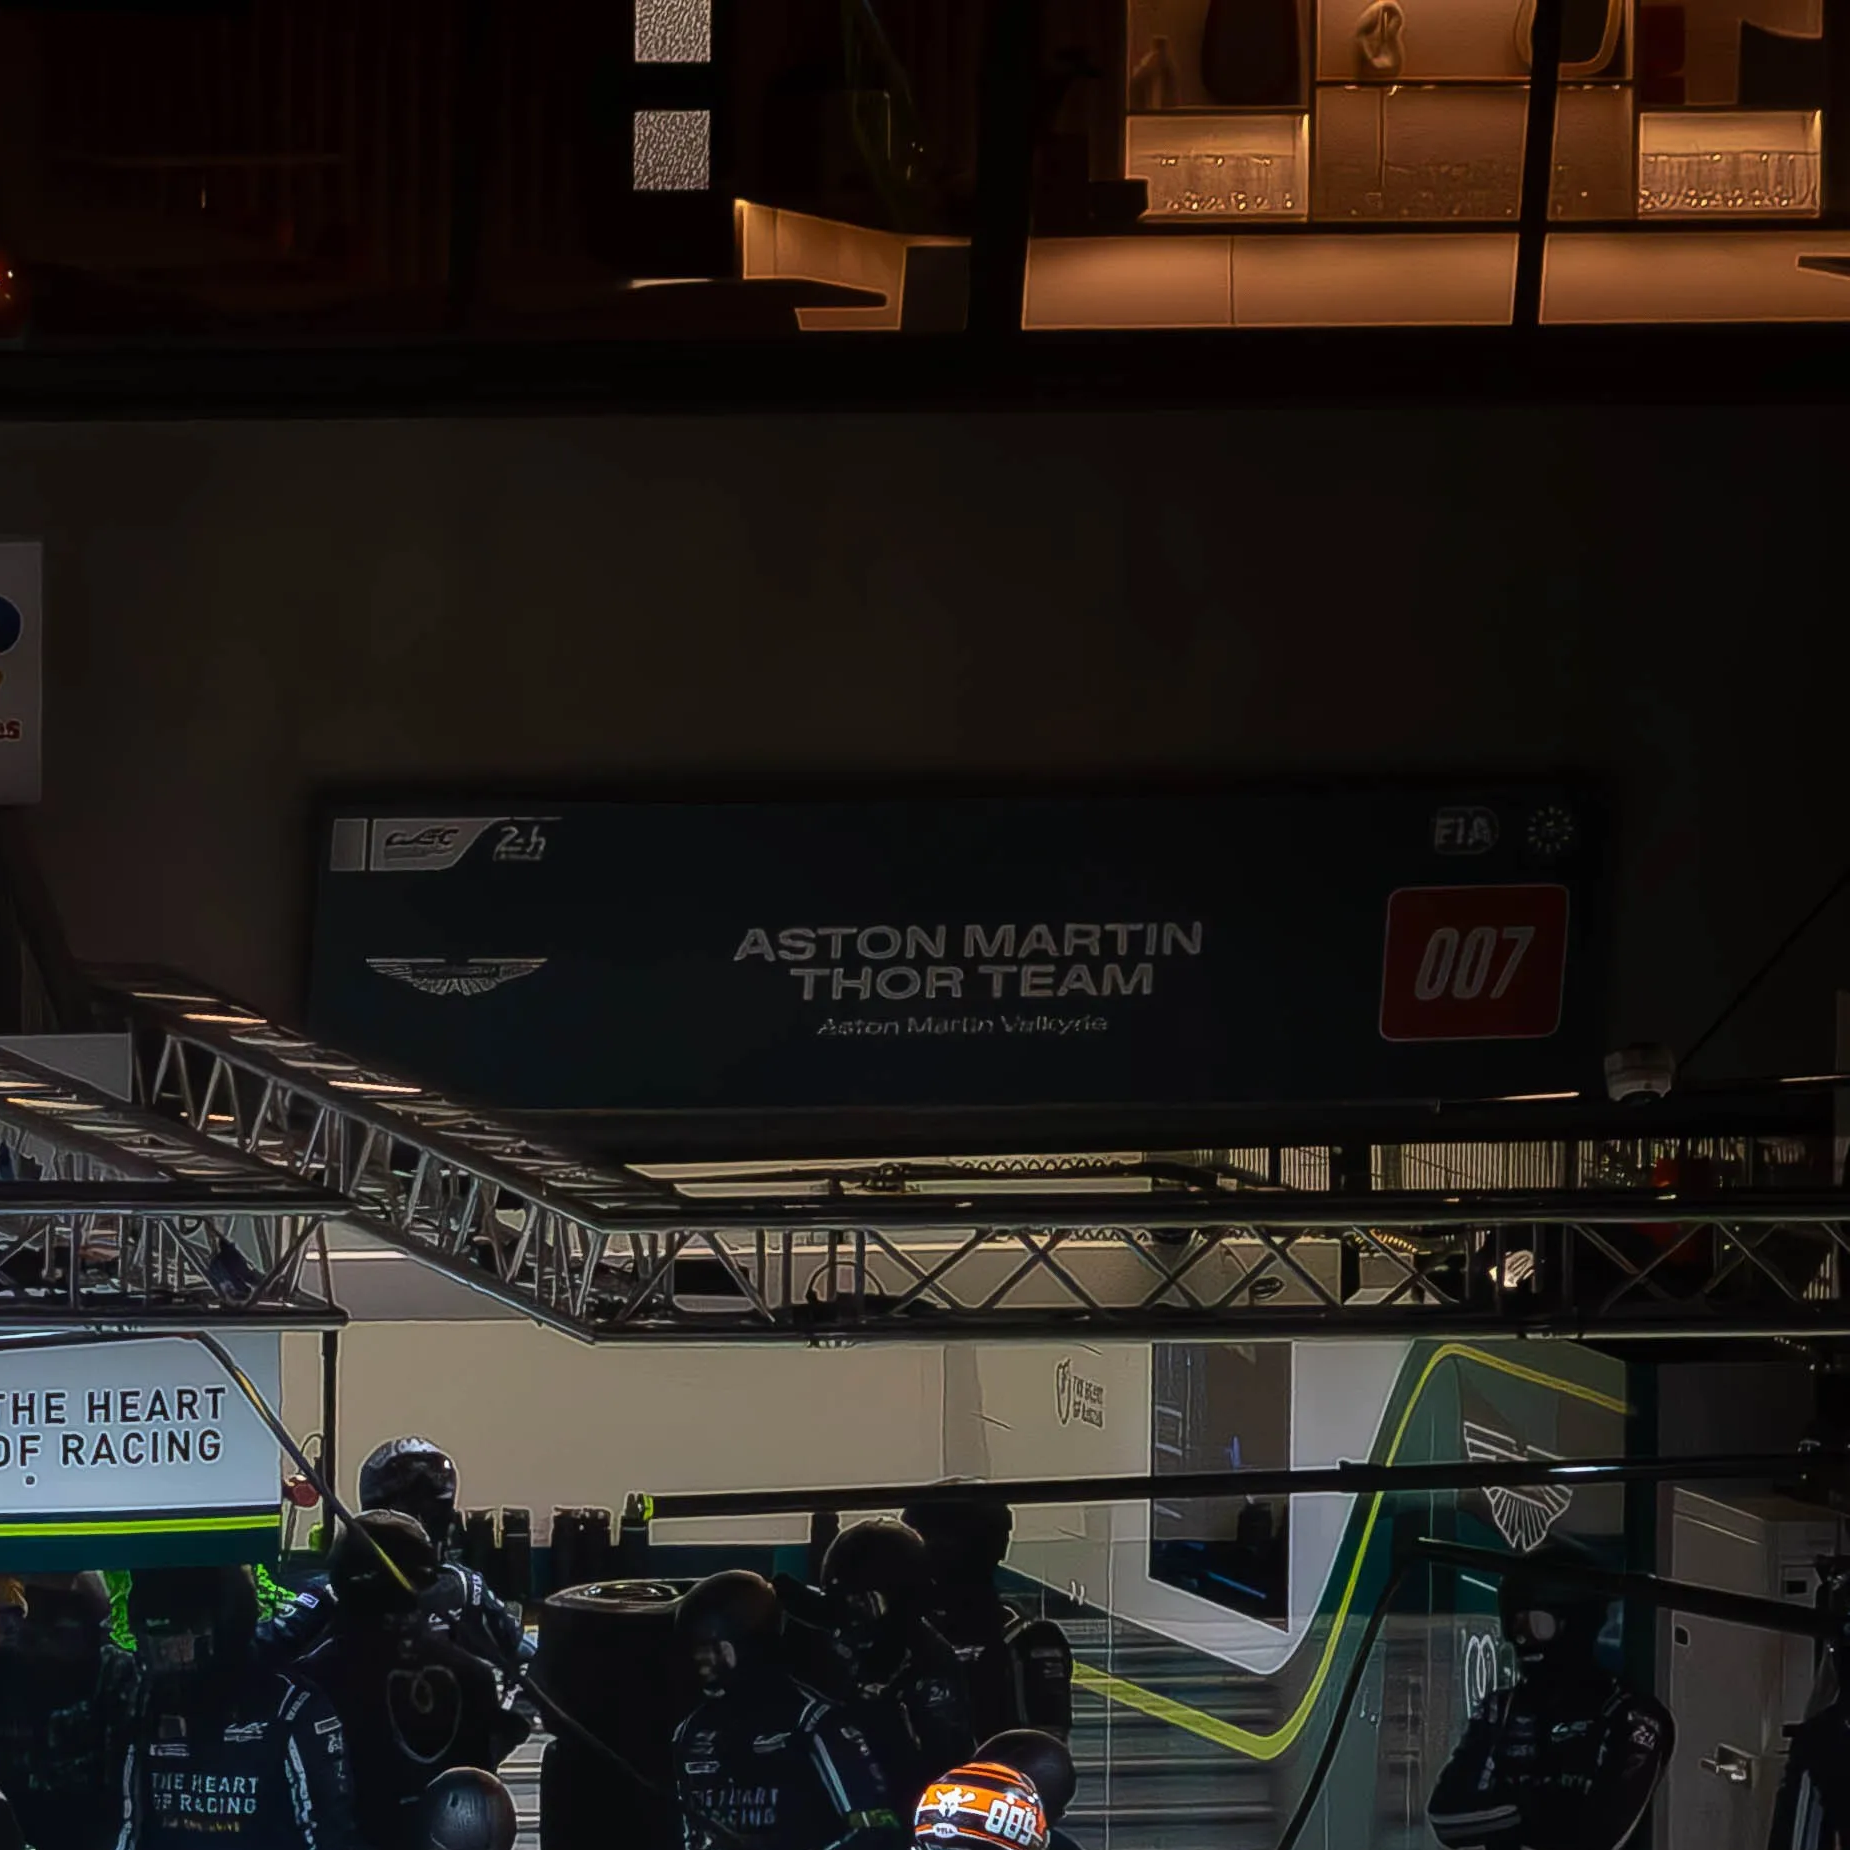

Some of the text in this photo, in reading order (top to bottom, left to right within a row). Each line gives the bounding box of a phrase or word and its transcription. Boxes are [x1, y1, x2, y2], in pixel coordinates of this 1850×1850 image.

[732, 919, 1204, 962] ASTON MARTIN
[789, 962, 1155, 1002] THOR TEAM
[1413, 924, 1537, 1001] 007
[87, 1386, 226, 1423] HEART
[61, 1428, 221, 1466] RACING
